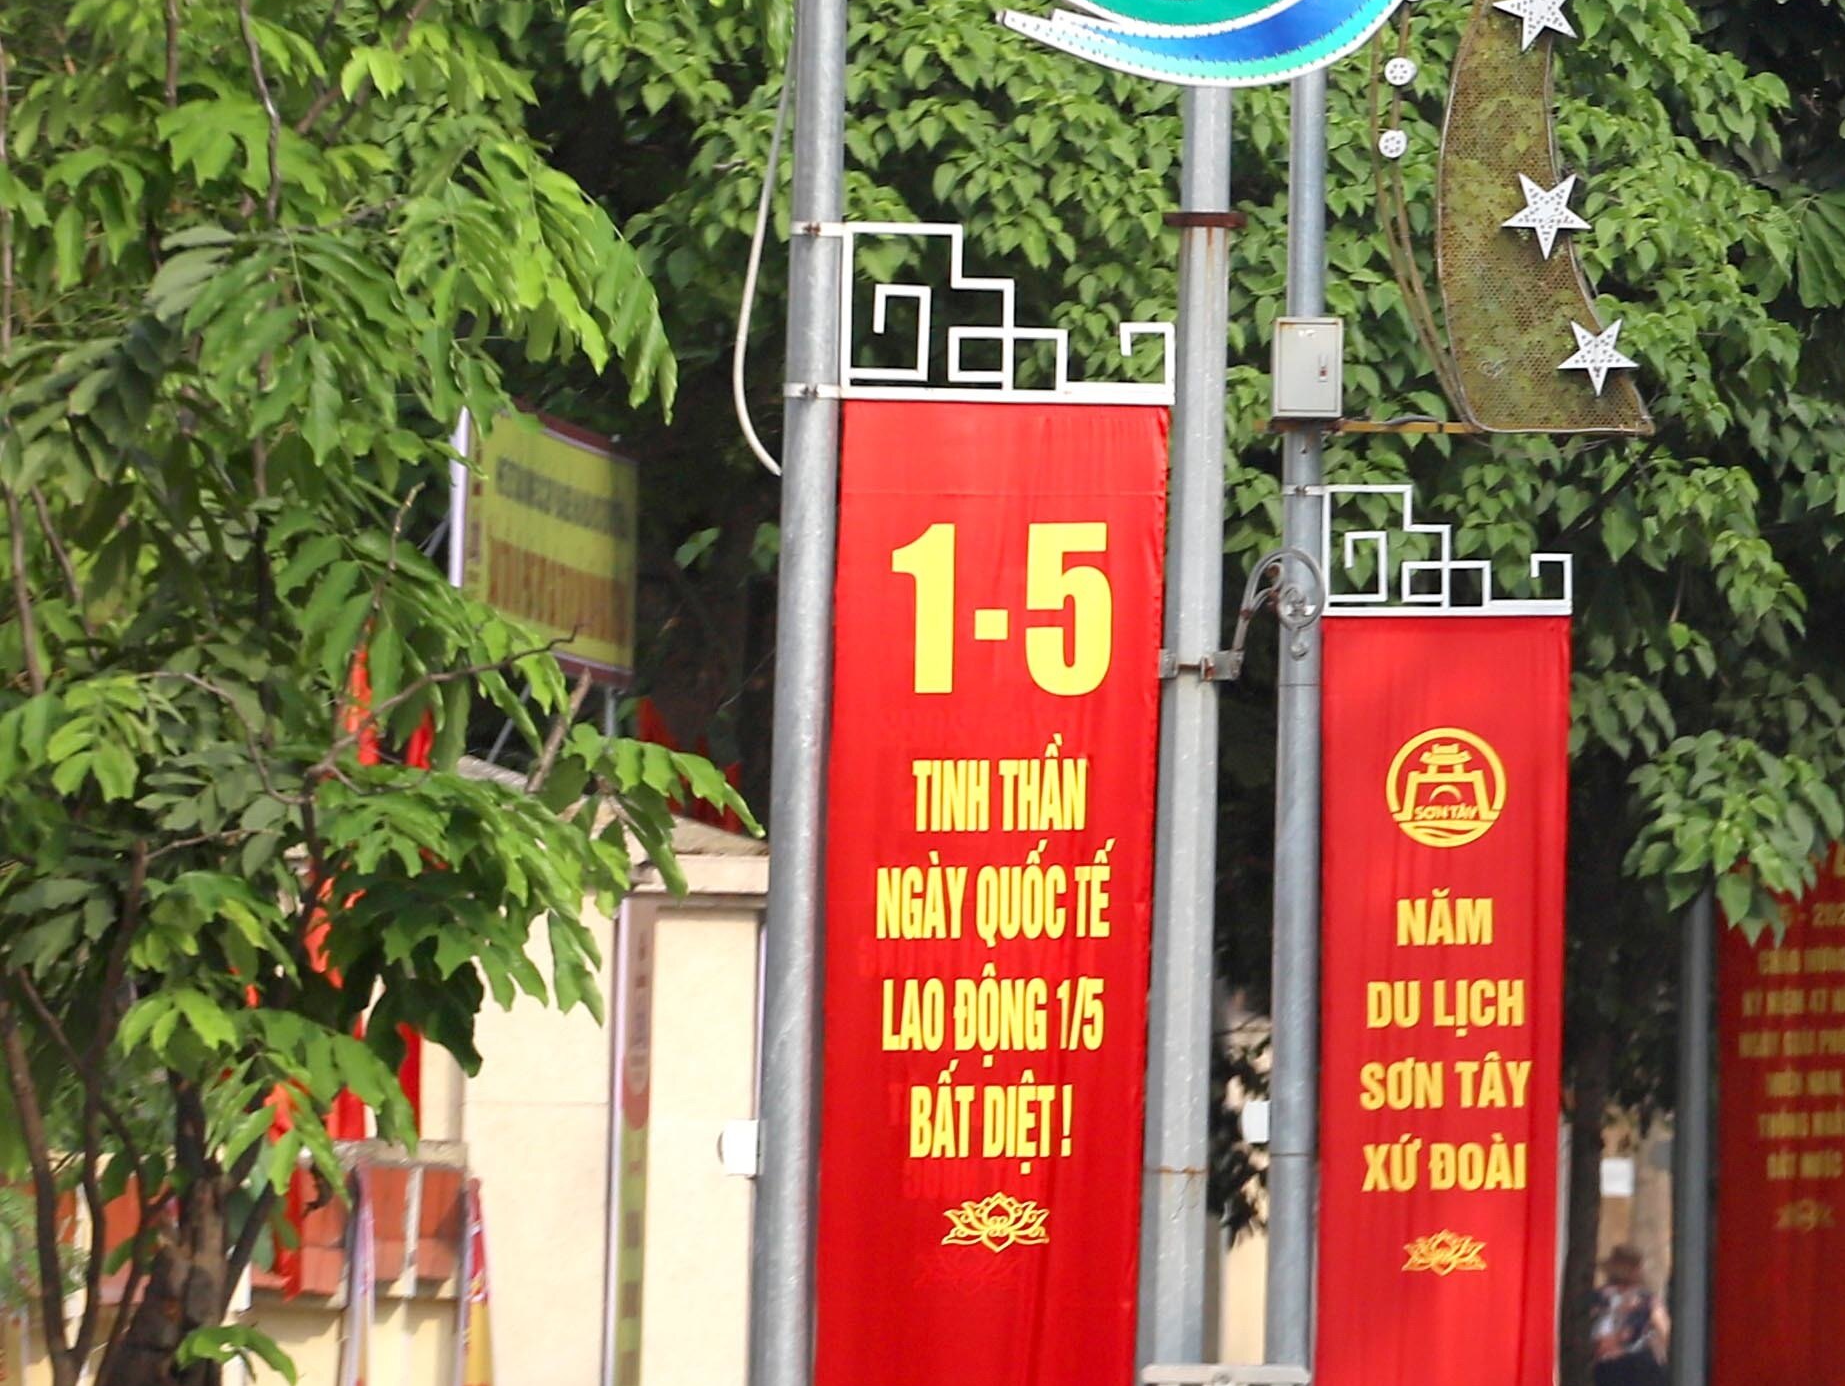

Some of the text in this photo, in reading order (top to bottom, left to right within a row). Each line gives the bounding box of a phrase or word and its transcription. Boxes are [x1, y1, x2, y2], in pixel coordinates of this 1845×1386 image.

[912, 732, 1088, 832] TINH THẦN
[876, 837, 1116, 948] NGÀY QUỐC TẾ
[1396, 887, 1493, 946] NĂM
[882, 962, 1105, 1068] LAO ĐỘNG 1/5
[1366, 978, 1525, 1037] DU LỊCH
[909, 1059, 976, 1158] BẤT
[1359, 1050, 1533, 1111] SƠN TÂY
[1361, 1132, 1528, 1192] XỨ ĐOÀI
